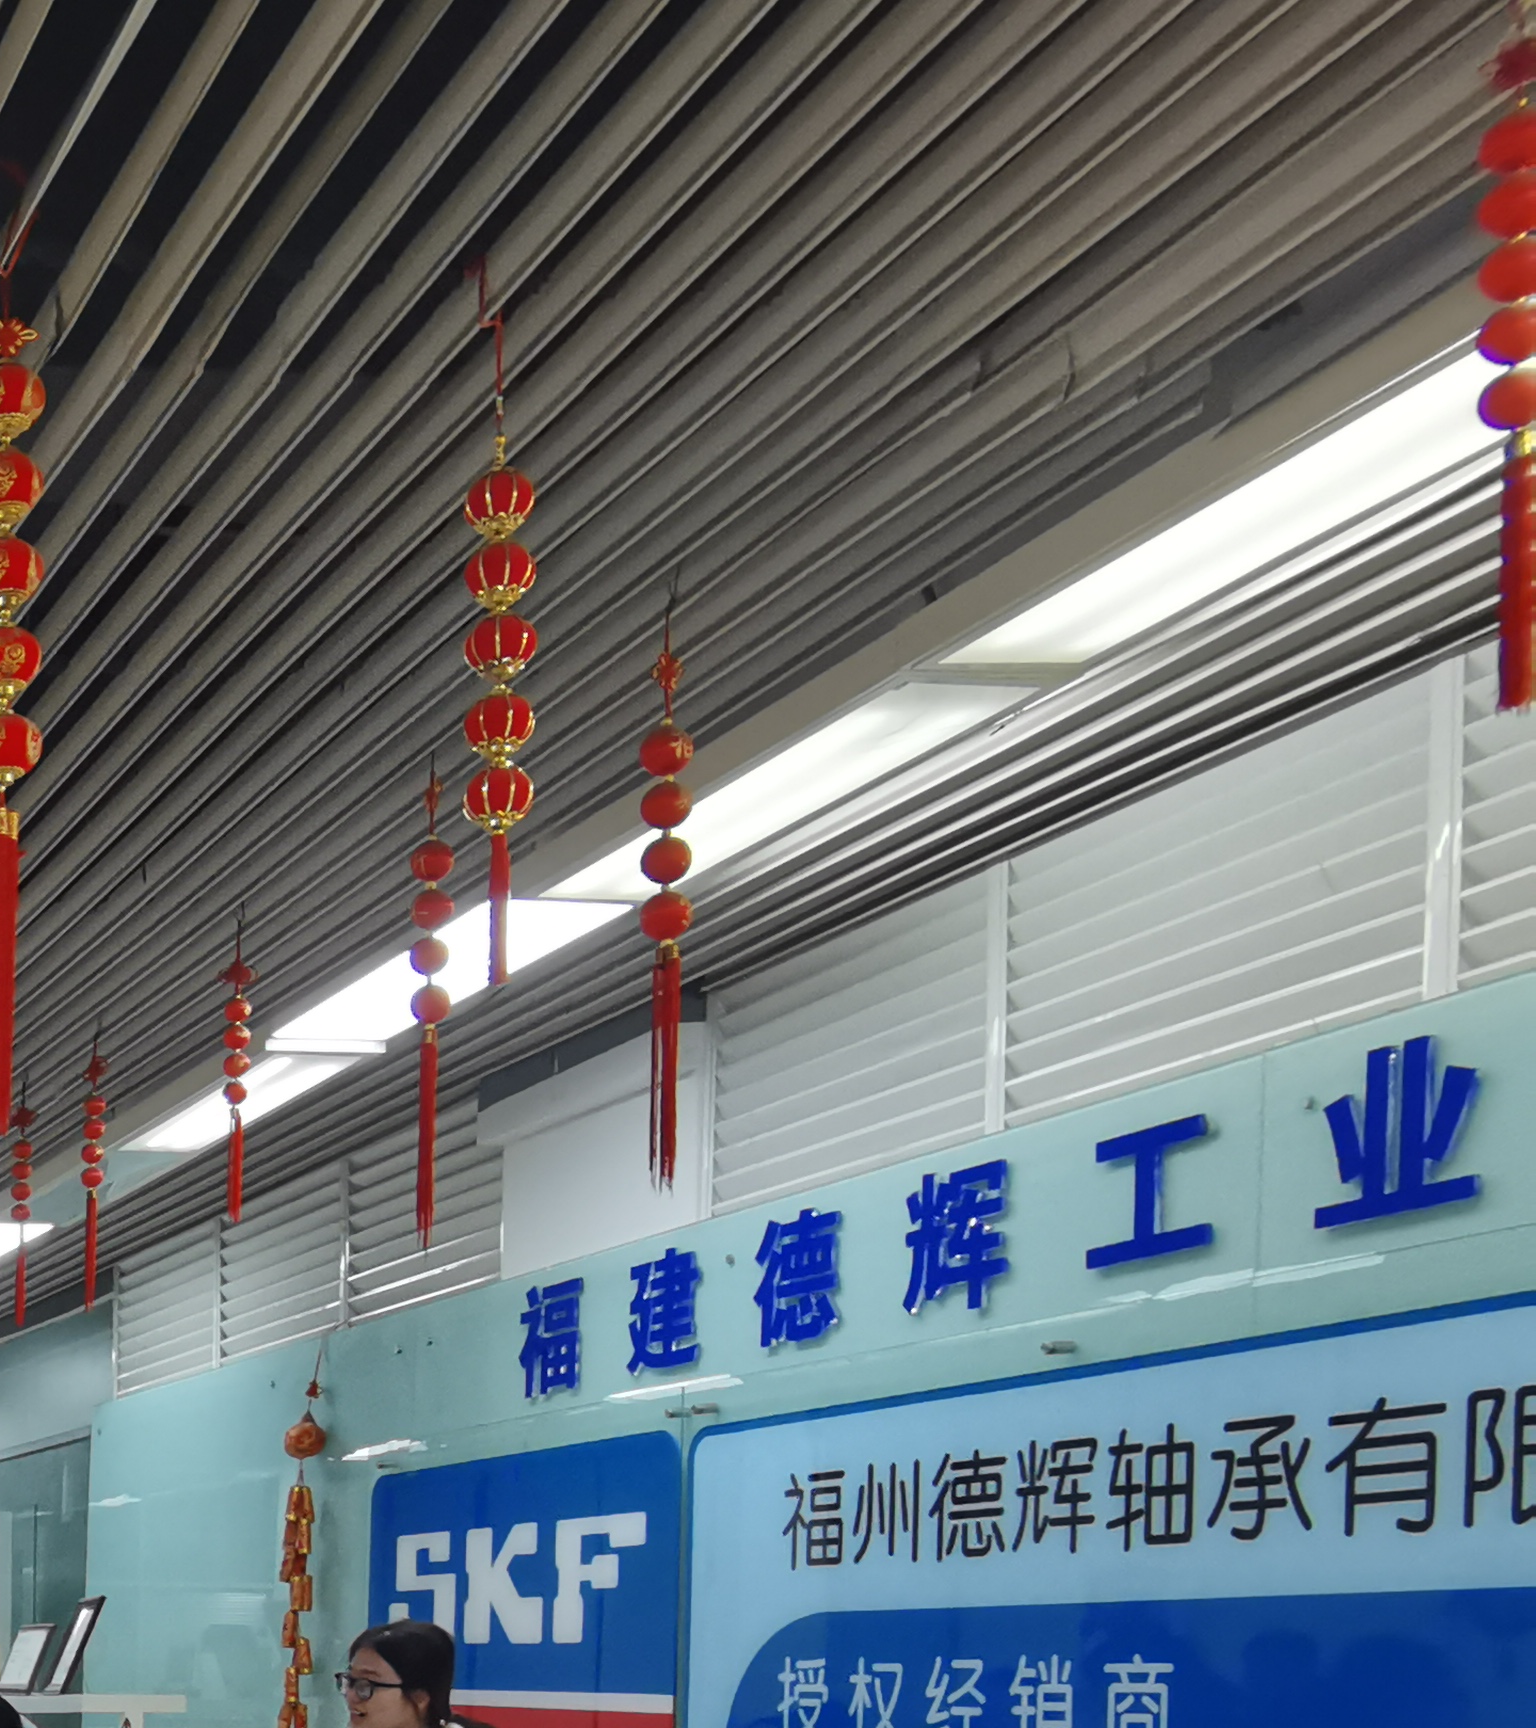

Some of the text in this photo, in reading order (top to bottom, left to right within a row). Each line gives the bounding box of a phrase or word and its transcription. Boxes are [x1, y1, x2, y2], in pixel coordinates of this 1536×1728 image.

[519, 1034, 1482, 1398] 福建德辉工业
[781, 1387, 1536, 1573] 福州德辉轴承有限
[388, 1511, 647, 1645] SKF
